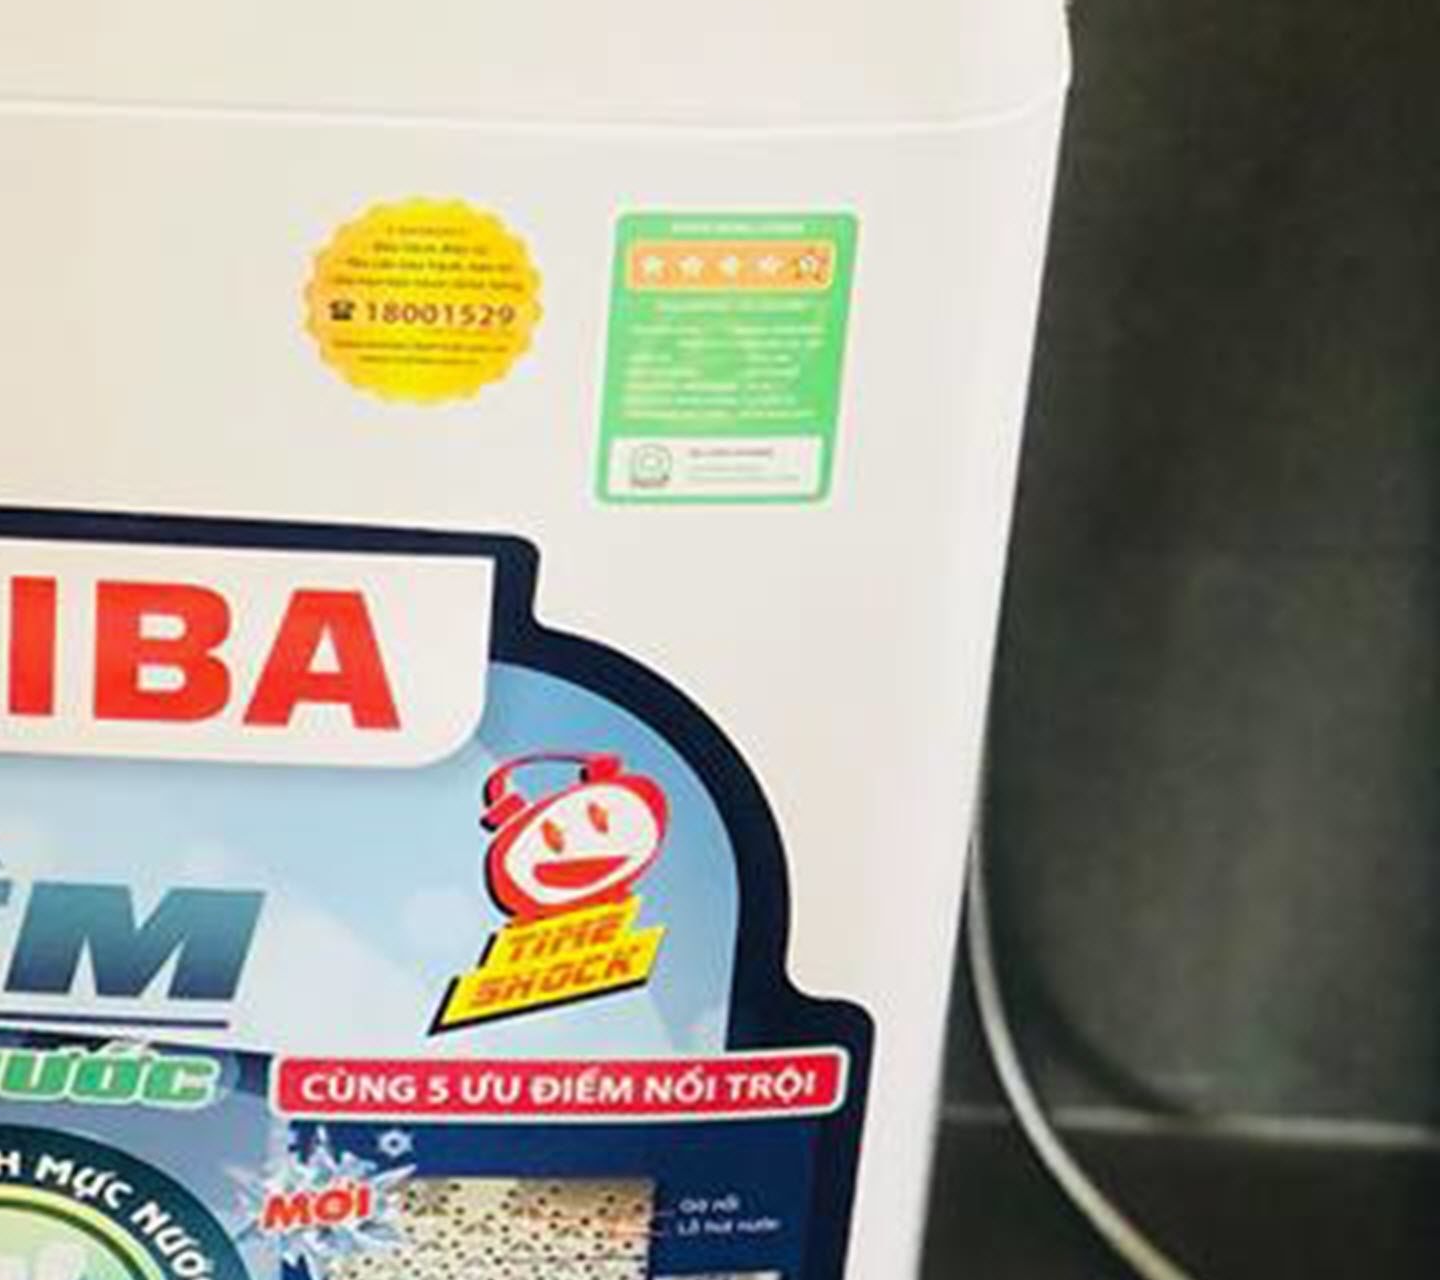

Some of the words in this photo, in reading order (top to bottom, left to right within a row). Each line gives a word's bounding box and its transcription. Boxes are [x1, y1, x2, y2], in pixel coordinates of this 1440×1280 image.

[365, 301, 517, 327] 18001529
[507, 912, 626, 962] TIME
[468, 945, 641, 1009] SHOCK
[301, 1066, 416, 1102] CÙNG
[428, 1075, 449, 1102] 5
[460, 1071, 520, 1104] ƯU
[531, 1066, 632, 1104] ĐIỂM
[644, 1065, 715, 1103] NỔI
[726, 1067, 816, 1105] TRỘI
